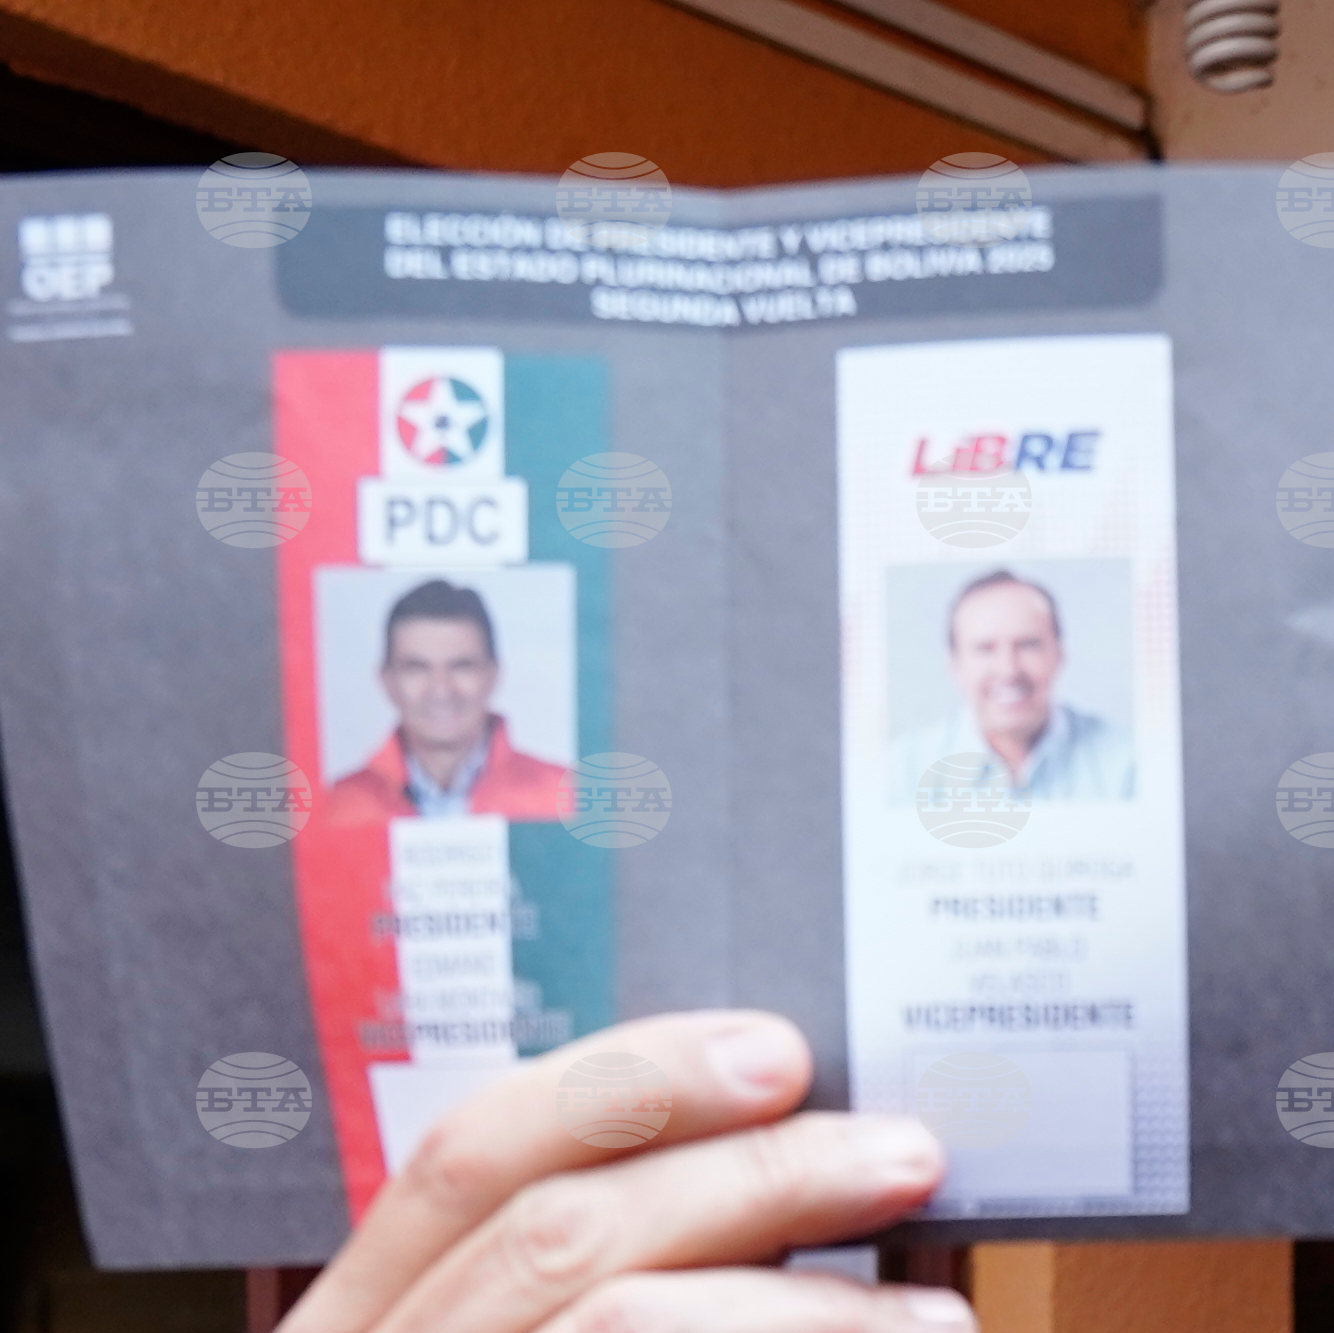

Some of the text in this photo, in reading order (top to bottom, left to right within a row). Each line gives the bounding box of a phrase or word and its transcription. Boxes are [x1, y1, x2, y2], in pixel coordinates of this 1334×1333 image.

[384, 498, 503, 547] PDC
[928, 892, 1100, 922] PRESIDENTE
[902, 1001, 1135, 1032] VICEPRESIDENTE
